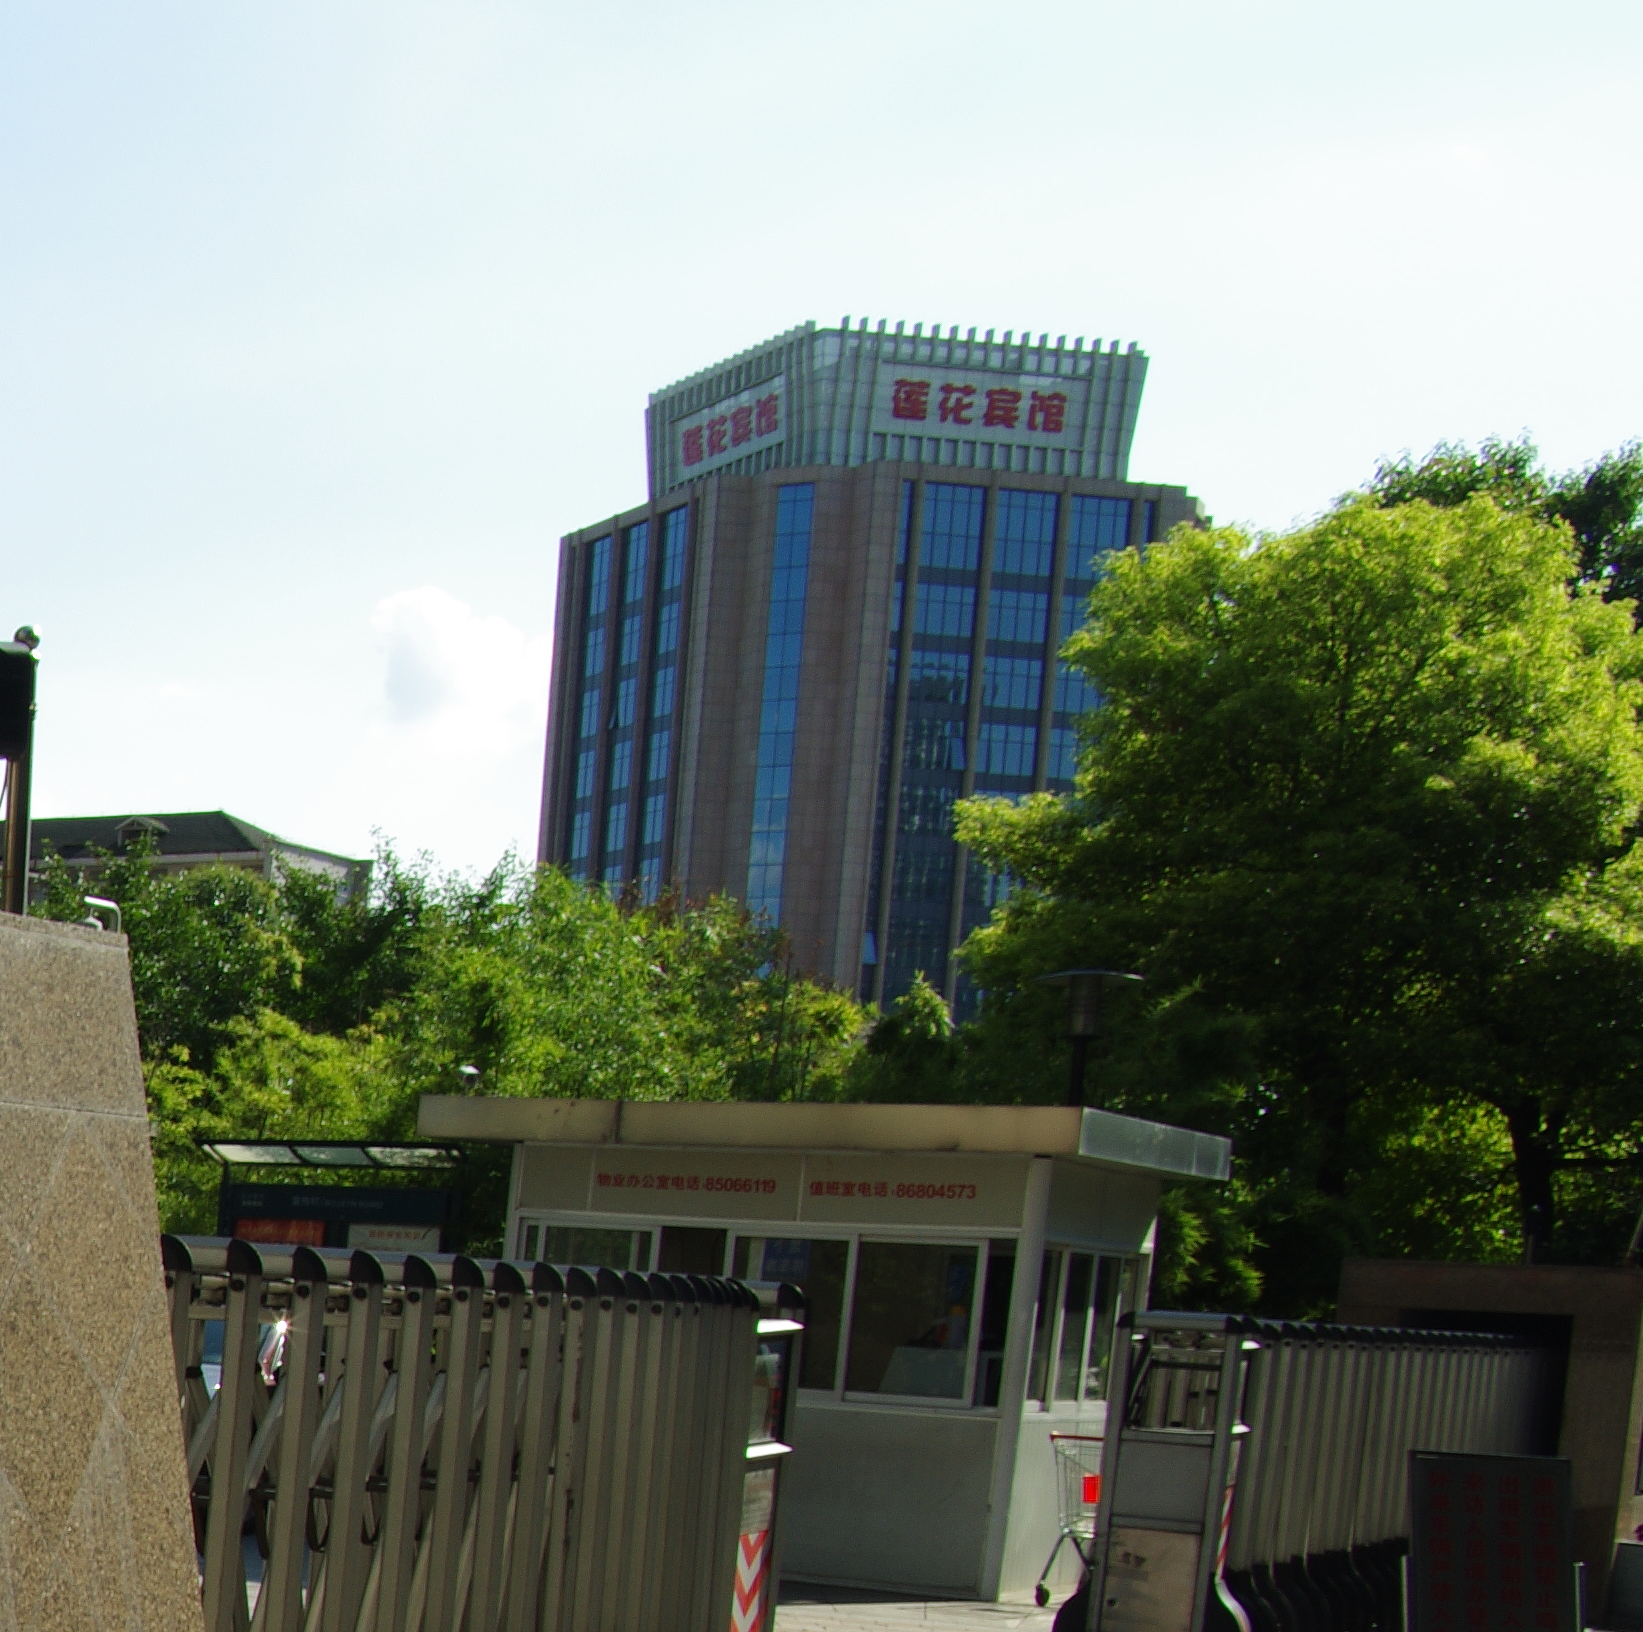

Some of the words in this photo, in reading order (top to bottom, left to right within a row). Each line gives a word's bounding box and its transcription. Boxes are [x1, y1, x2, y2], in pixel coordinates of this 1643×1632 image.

[681, 391, 780, 467] 莲花宾馆
[891, 377, 1068, 434] 莲花宾馆
